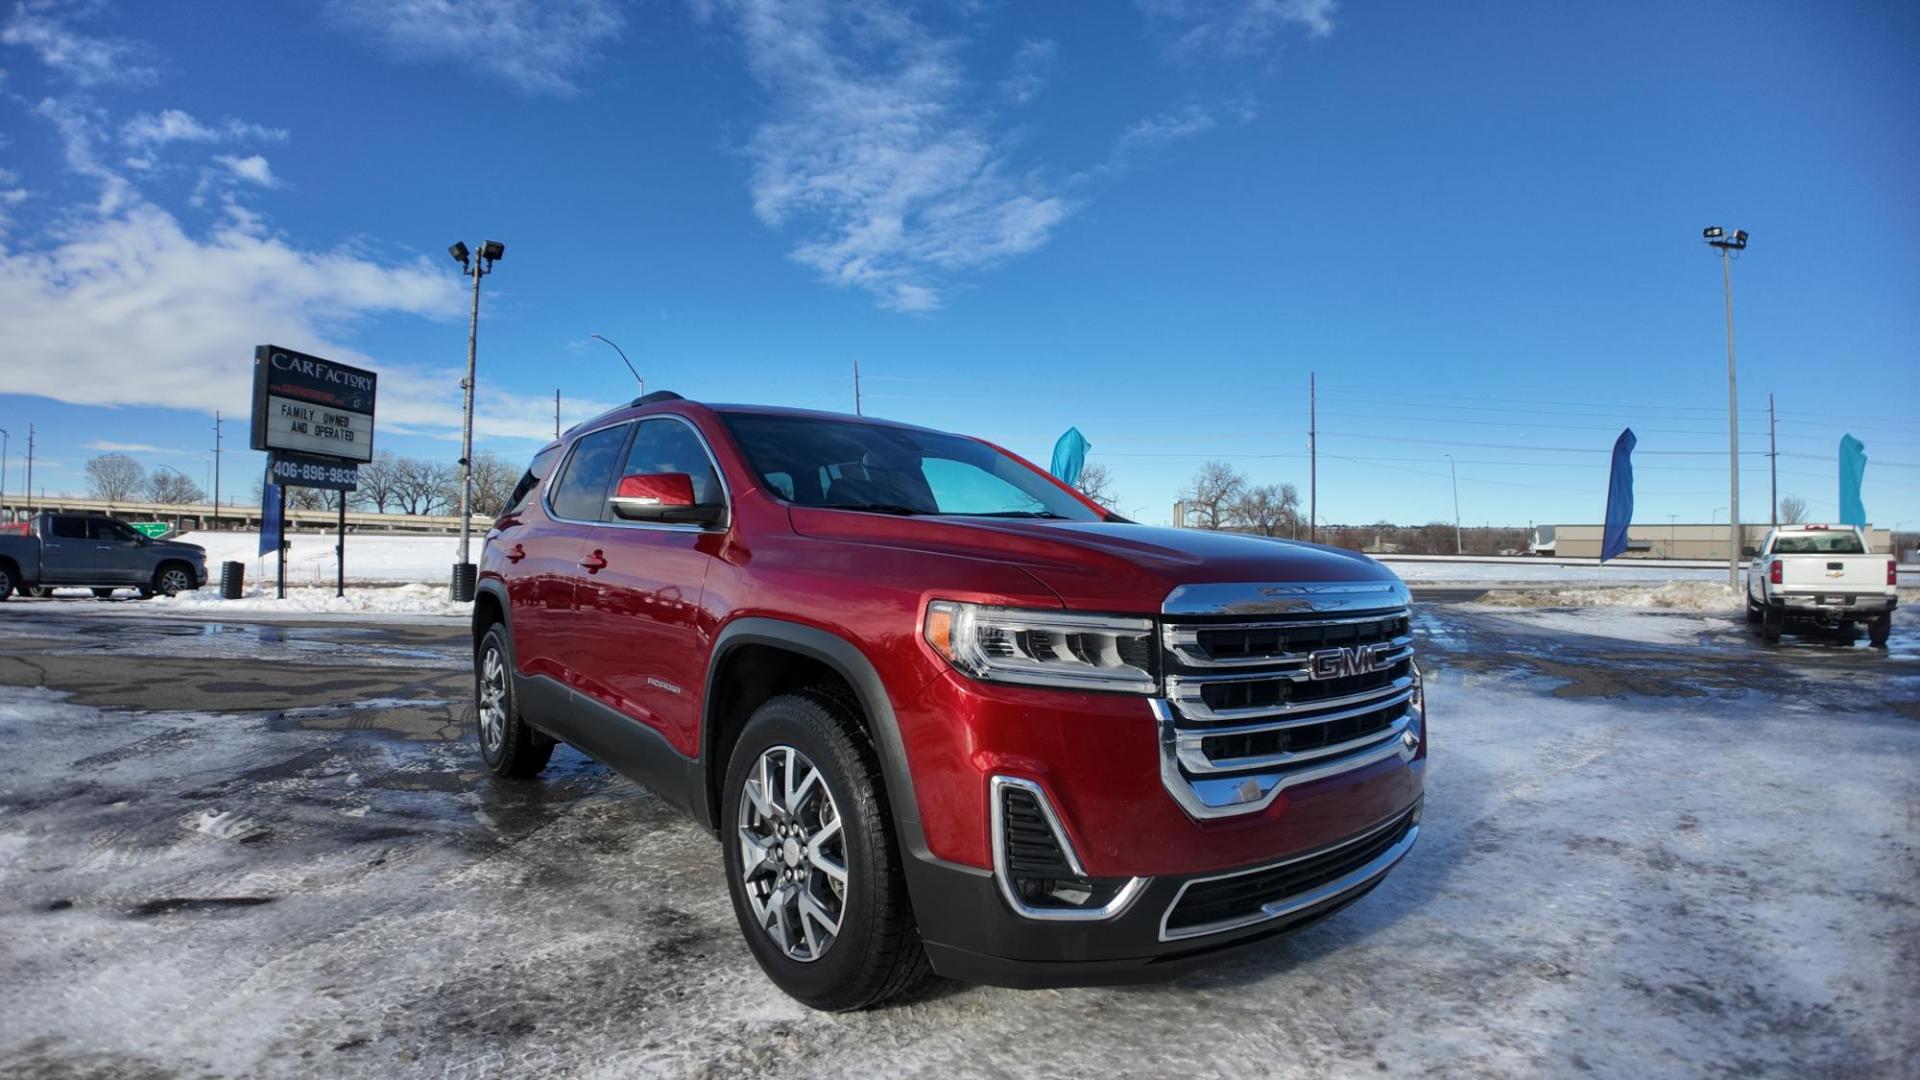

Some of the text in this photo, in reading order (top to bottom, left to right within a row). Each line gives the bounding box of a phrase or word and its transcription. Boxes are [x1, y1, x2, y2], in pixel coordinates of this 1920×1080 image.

[281, 404, 350, 428] FAMILY OWNED
[291, 421, 354, 442] AND OPERATED
[273, 461, 357, 484] 406-896-9833
[1308, 643, 1394, 681] GMC
